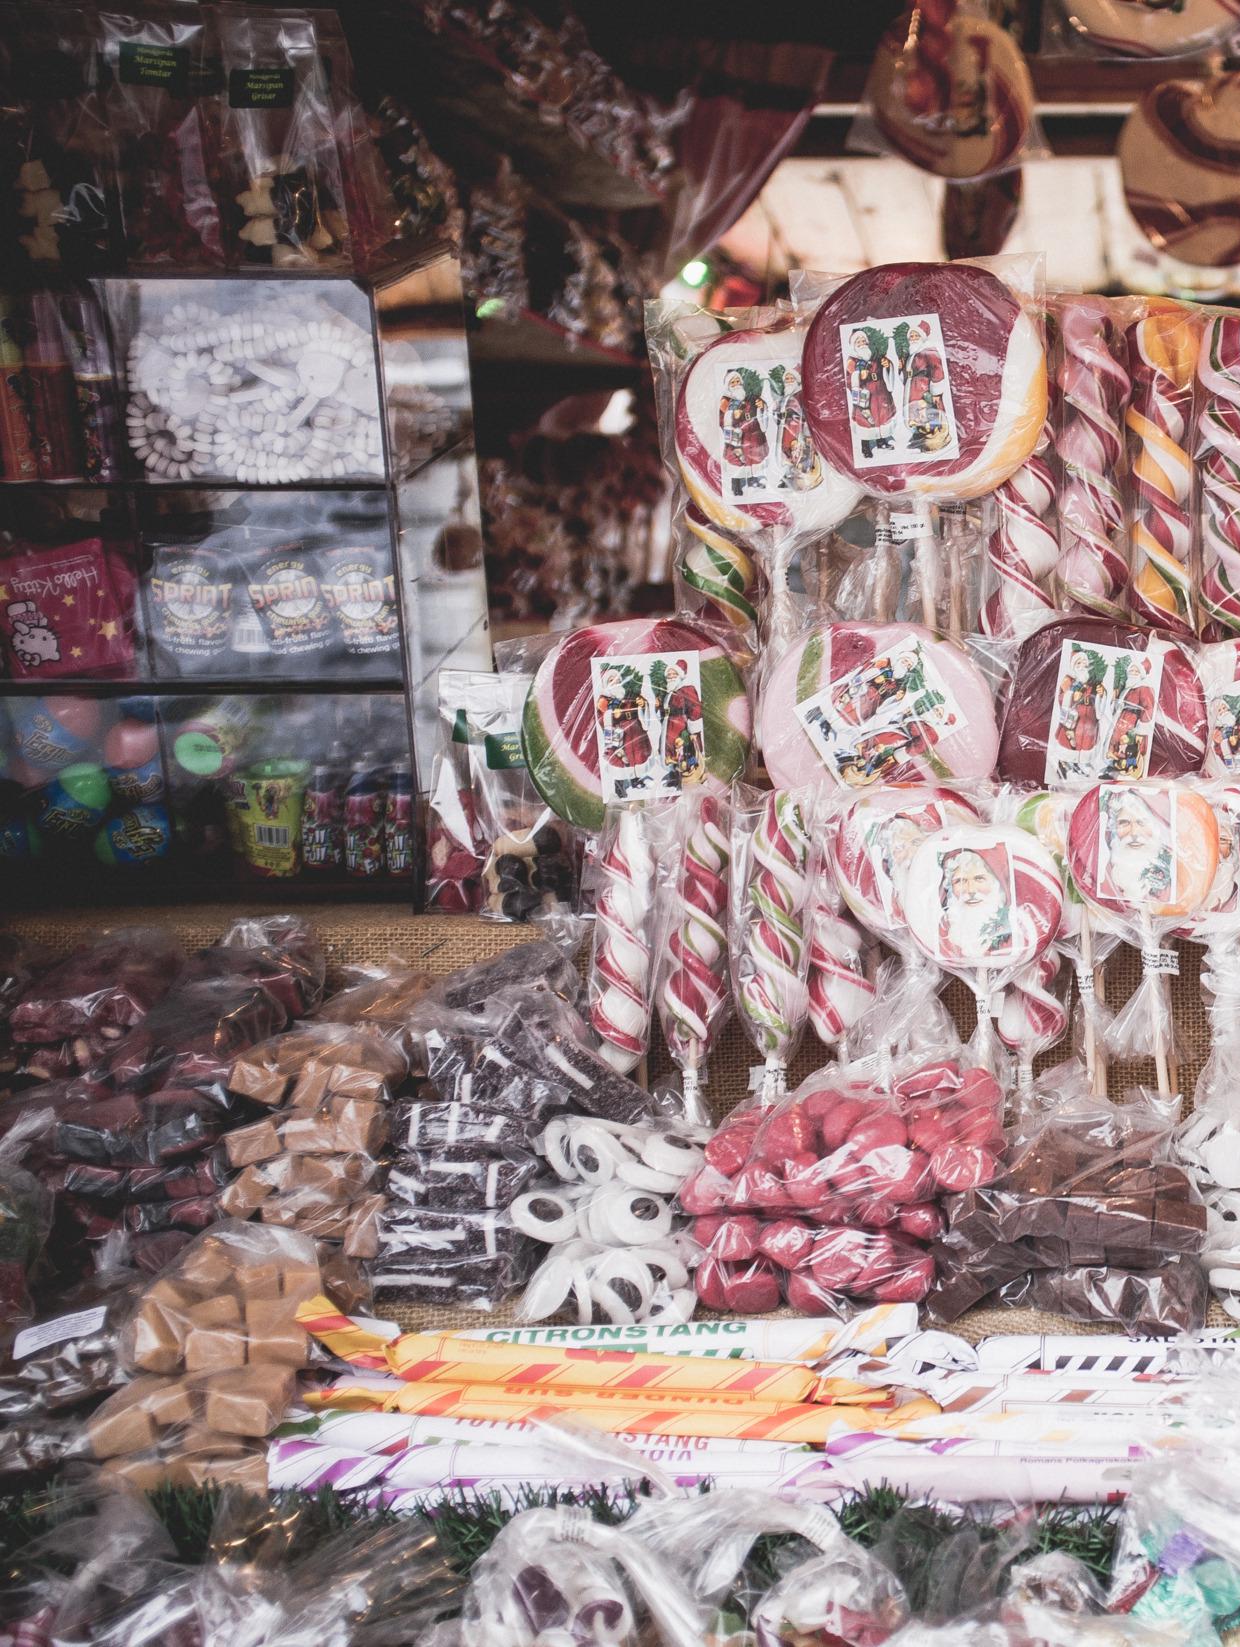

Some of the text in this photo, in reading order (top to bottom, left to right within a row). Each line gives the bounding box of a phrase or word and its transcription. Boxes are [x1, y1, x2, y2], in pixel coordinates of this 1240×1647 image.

[171, 562, 210, 578] energy
[266, 560, 304, 577] energy
[336, 562, 373, 577] energy
[10, 566, 98, 599] Hello Kitty
[151, 577, 233, 609] SPRINT
[321, 575, 396, 609] SPRINT
